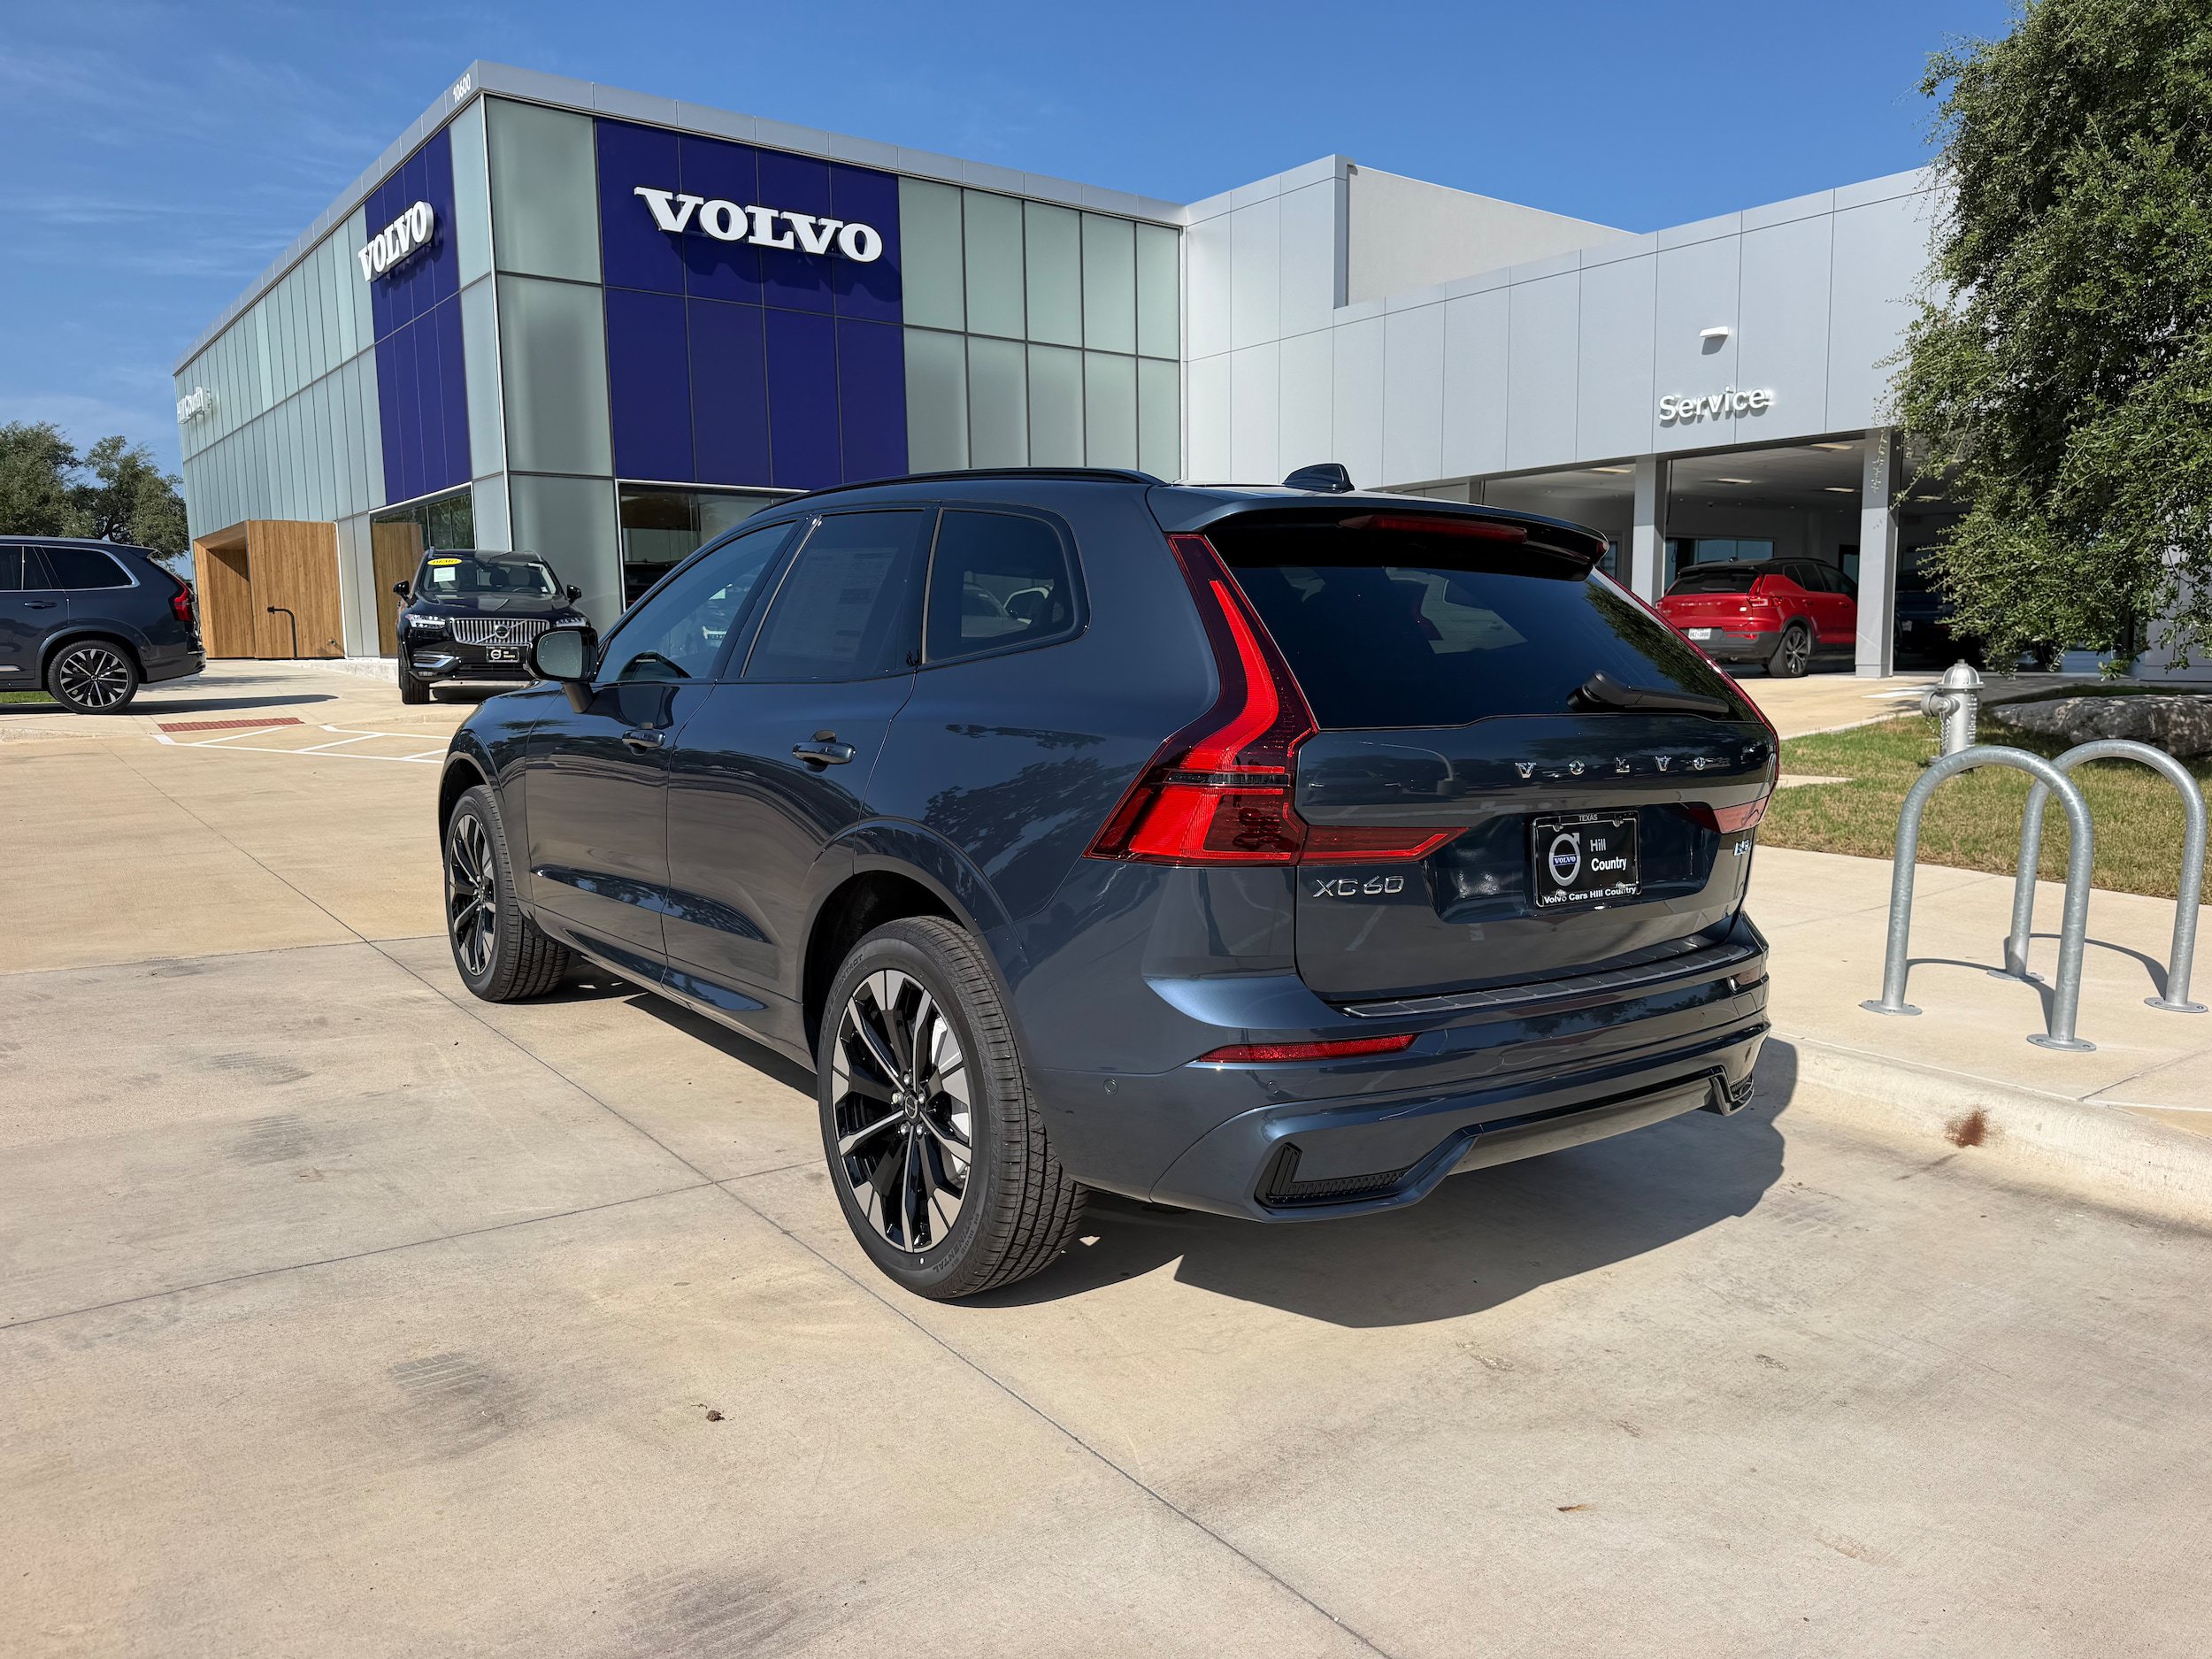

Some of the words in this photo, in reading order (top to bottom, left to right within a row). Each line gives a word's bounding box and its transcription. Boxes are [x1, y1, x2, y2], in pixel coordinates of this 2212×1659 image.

[452, 73, 471, 104] 10600
[634, 187, 883, 263] VOLVO
[357, 200, 434, 281] VOLVO
[1659, 386, 1768, 421] Service
[1514, 756, 1707, 779] VOLVO
[1578, 813, 1598, 822] TEXAS
[1590, 837, 1607, 852] Hill
[1553, 856, 1577, 864] VOLVO
[1590, 856, 1627, 872] Country
[1543, 895, 1567, 905] Volvo
[1568, 892, 1588, 902] Cars
[1589, 889, 1603, 899] Hill
[1604, 886, 1637, 896] Country
